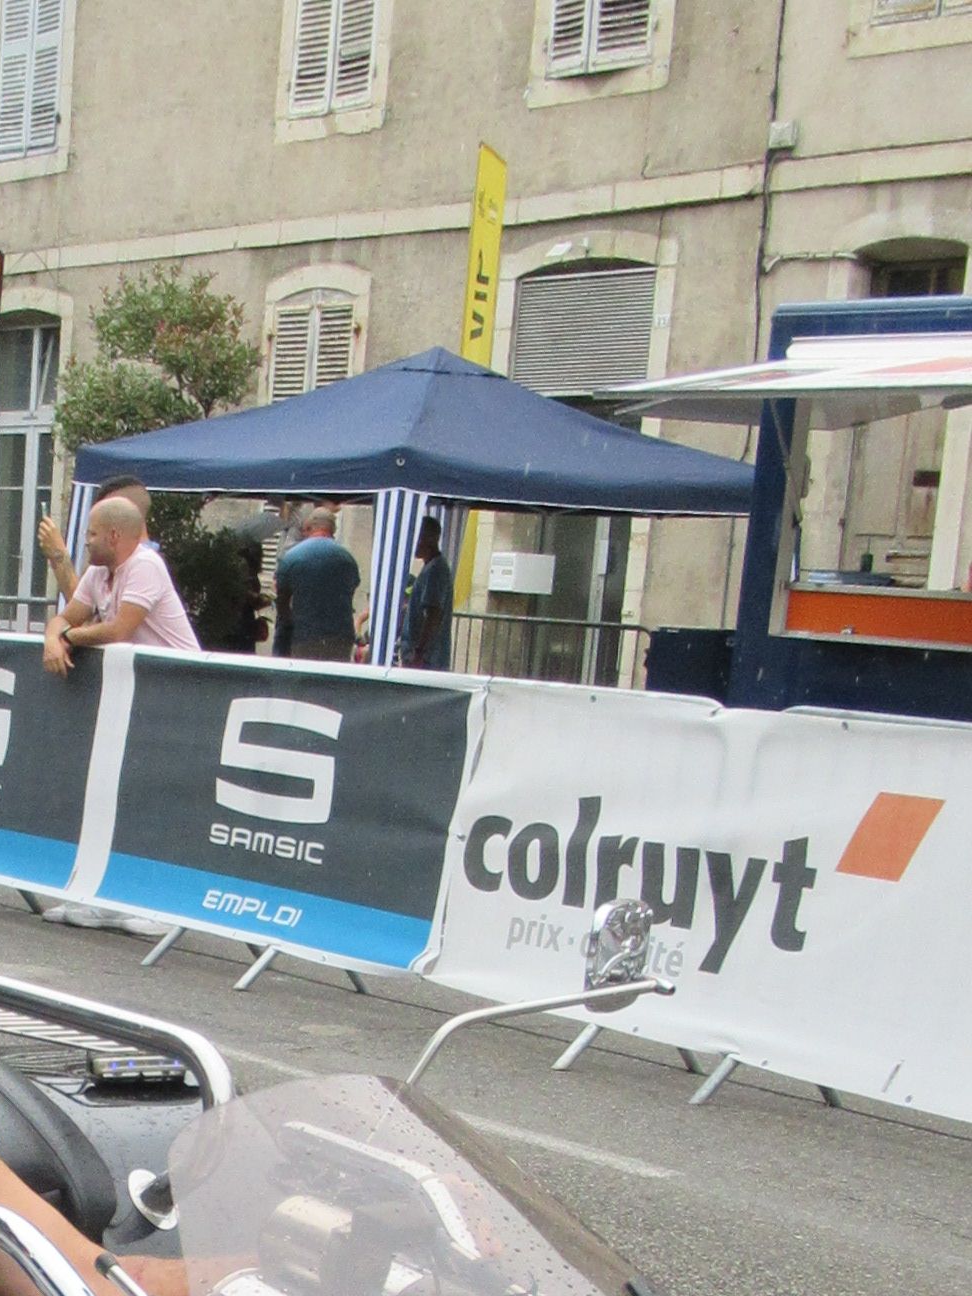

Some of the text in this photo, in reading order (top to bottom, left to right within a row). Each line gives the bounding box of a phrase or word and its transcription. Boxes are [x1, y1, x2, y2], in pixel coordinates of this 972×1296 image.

[215, 696, 343, 824] S
[208, 823, 325, 866] SAMSIC
[463, 795, 818, 975] colruyt
[201, 888, 303, 928] EMPLOI
[506, 913, 564, 952] prix
